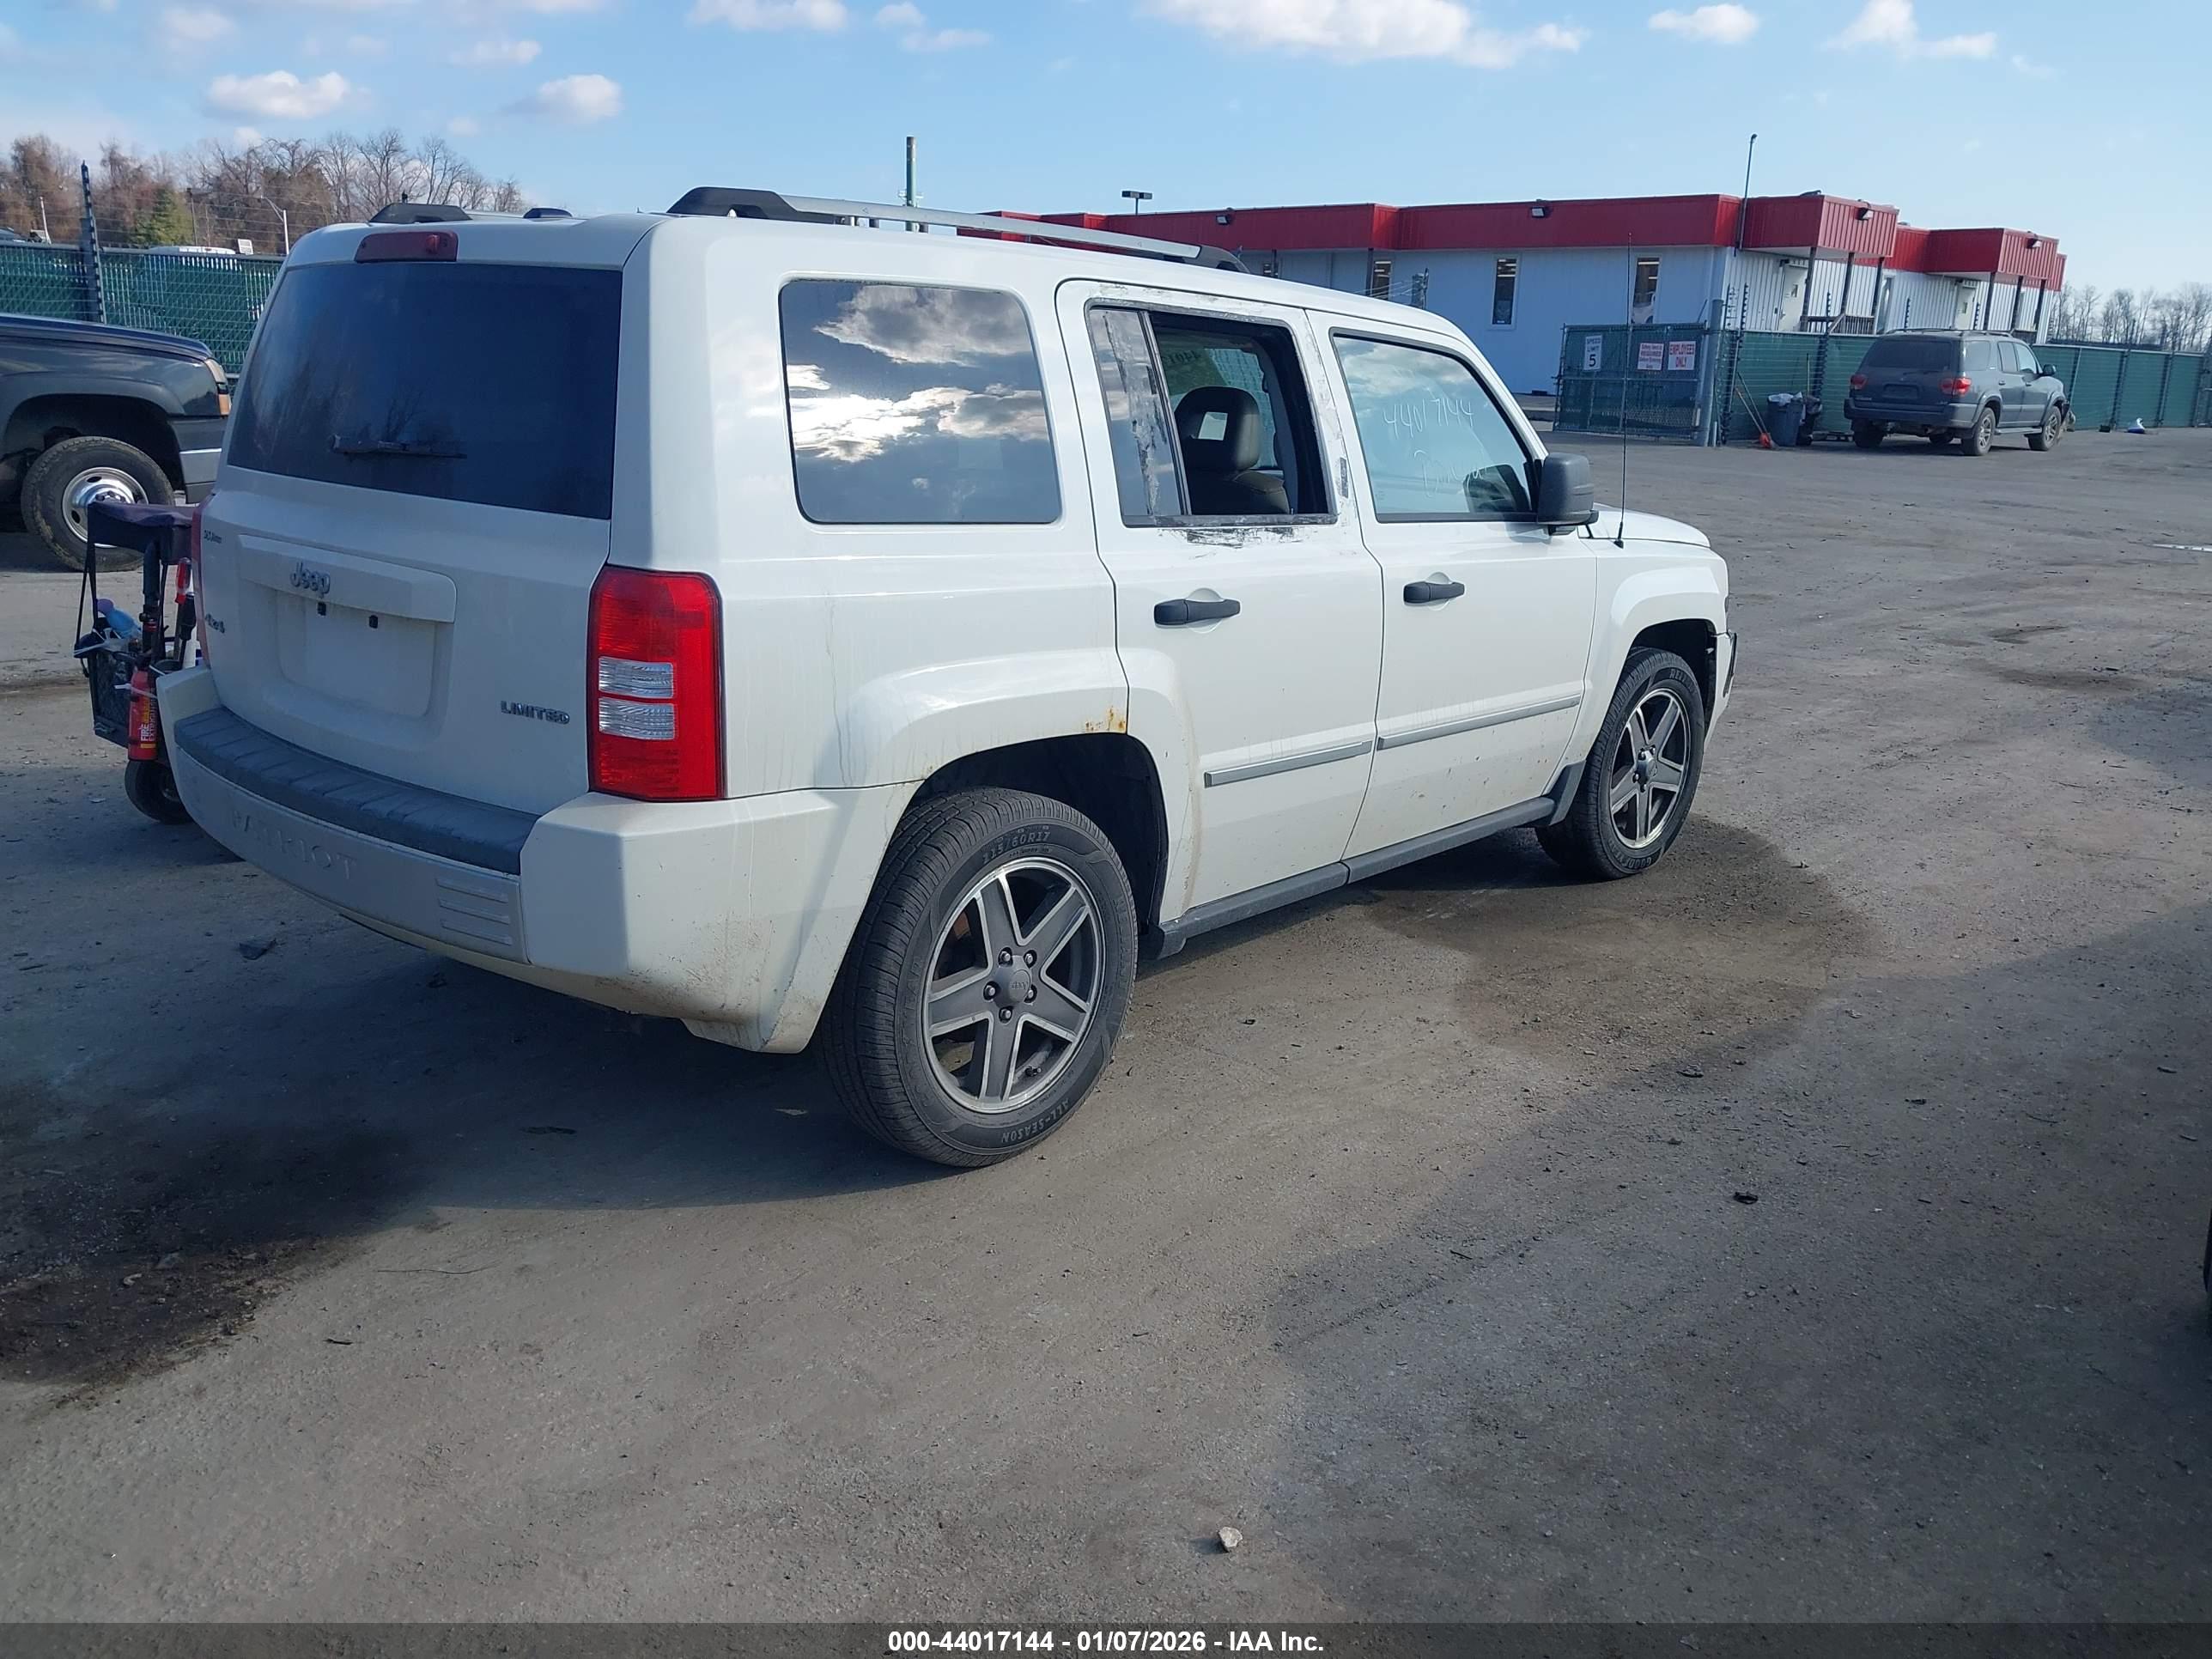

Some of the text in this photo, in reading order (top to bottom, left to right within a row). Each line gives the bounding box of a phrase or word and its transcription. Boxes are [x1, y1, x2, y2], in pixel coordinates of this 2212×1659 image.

[1589, 354, 1596, 368] 5
[1669, 344, 1694, 356] EMPLOYEES
[1675, 356, 1687, 368] ONLY
[289, 562, 331, 599] Jeep
[501, 700, 570, 725] LIMITED
[140, 723, 149, 742] FIRE
[231, 809, 358, 880] PATRIOT
[1001, 1097, 1070, 1143] ALL-SEASON
